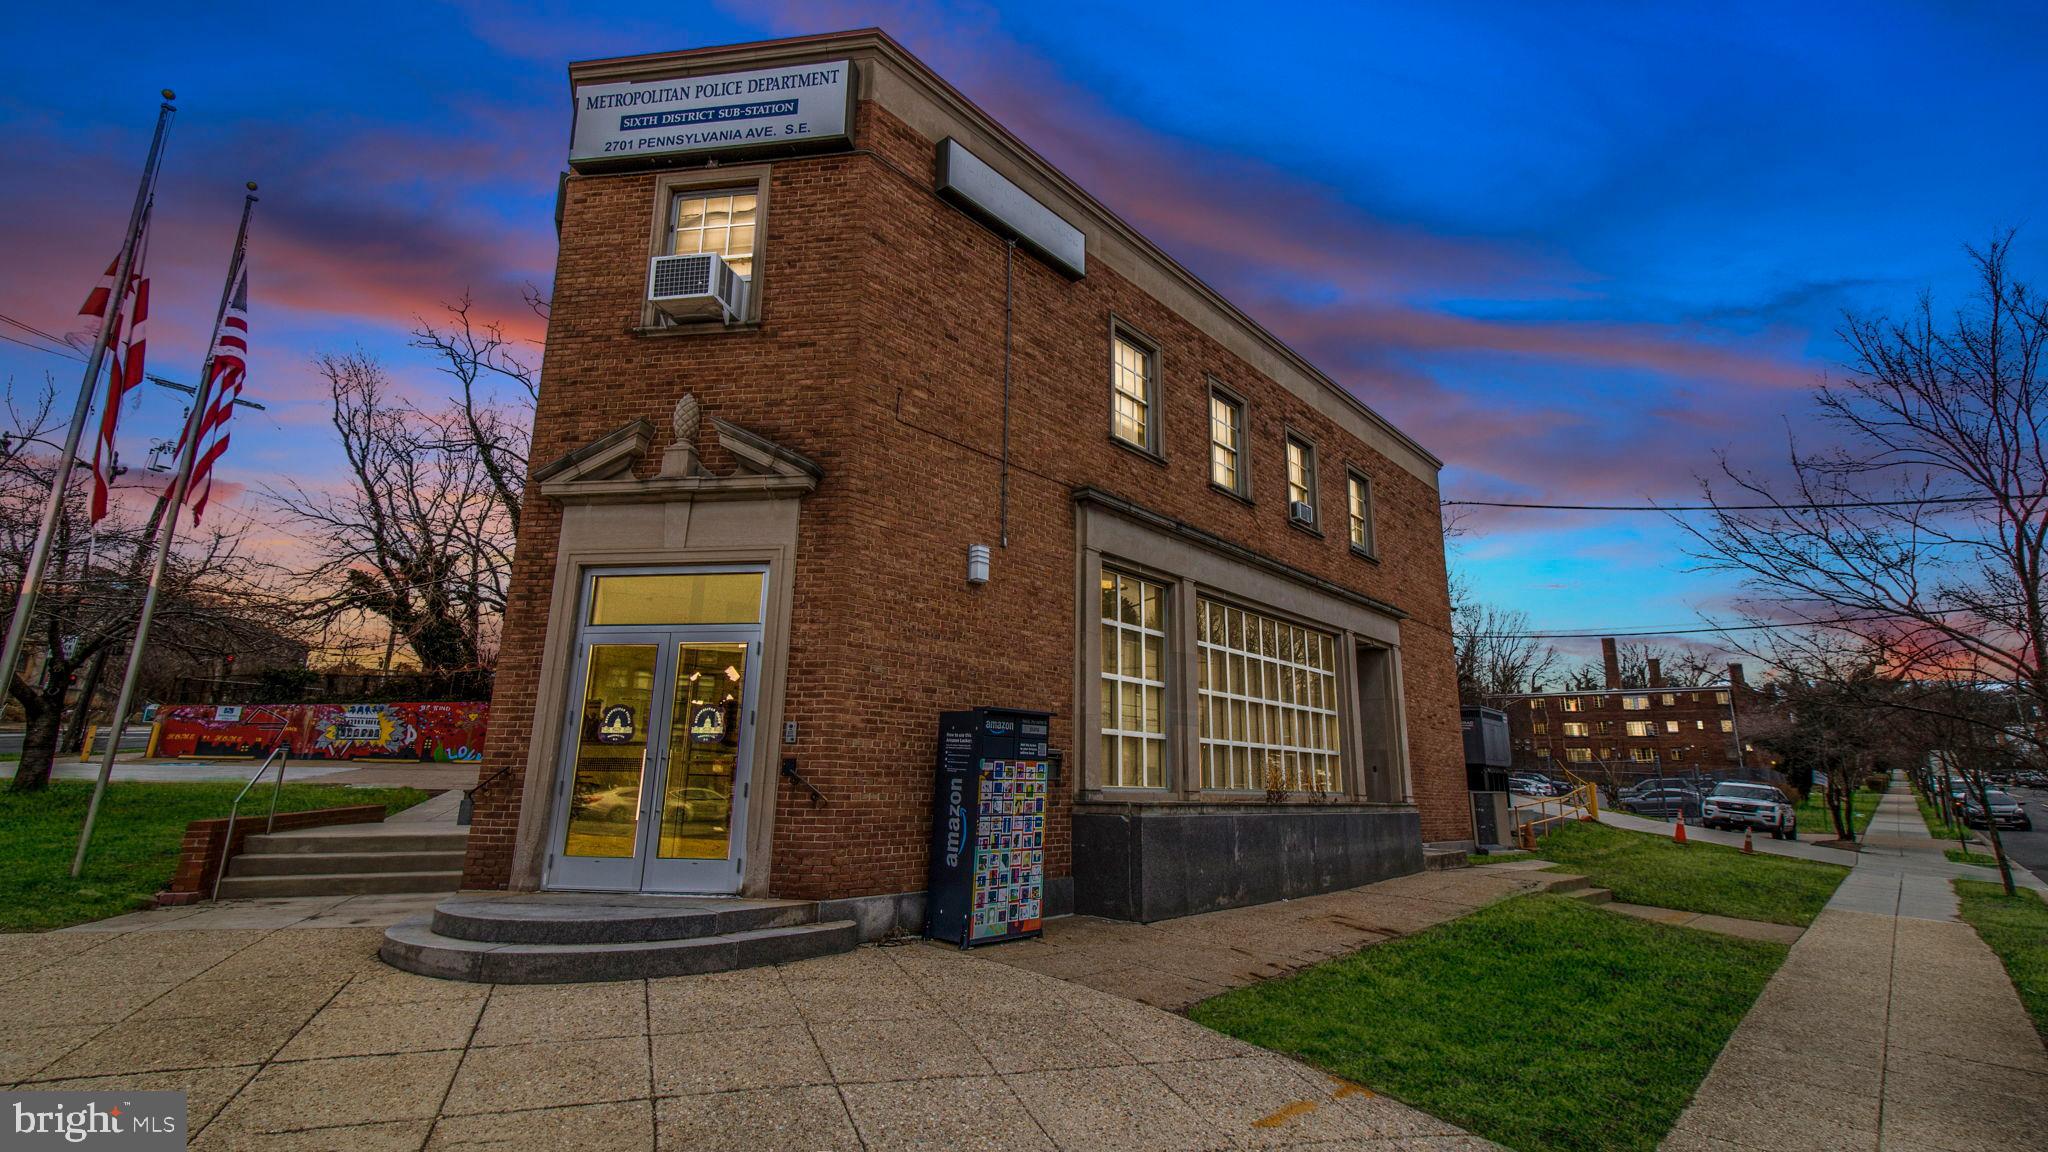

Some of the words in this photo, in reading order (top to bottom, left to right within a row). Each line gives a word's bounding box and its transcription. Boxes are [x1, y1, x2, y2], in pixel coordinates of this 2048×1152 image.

[586, 86, 690, 110] METROPOLITAN
[695, 80, 742, 100] POLICE
[748, 69, 840, 94] DEPARTMENT
[623, 114, 658, 128] SIXTH
[662, 110, 715, 124] DISTRICT
[718, 102, 795, 119] SUB-STATION
[604, 140, 634, 152] 2701
[638, 129, 742, 150] PENNSYLVANIA
[746, 126, 777, 139] AVE.
[785, 122, 811, 135] S.E.
[985, 719, 1014, 731] amazon
[946, 778, 963, 868] amazon
